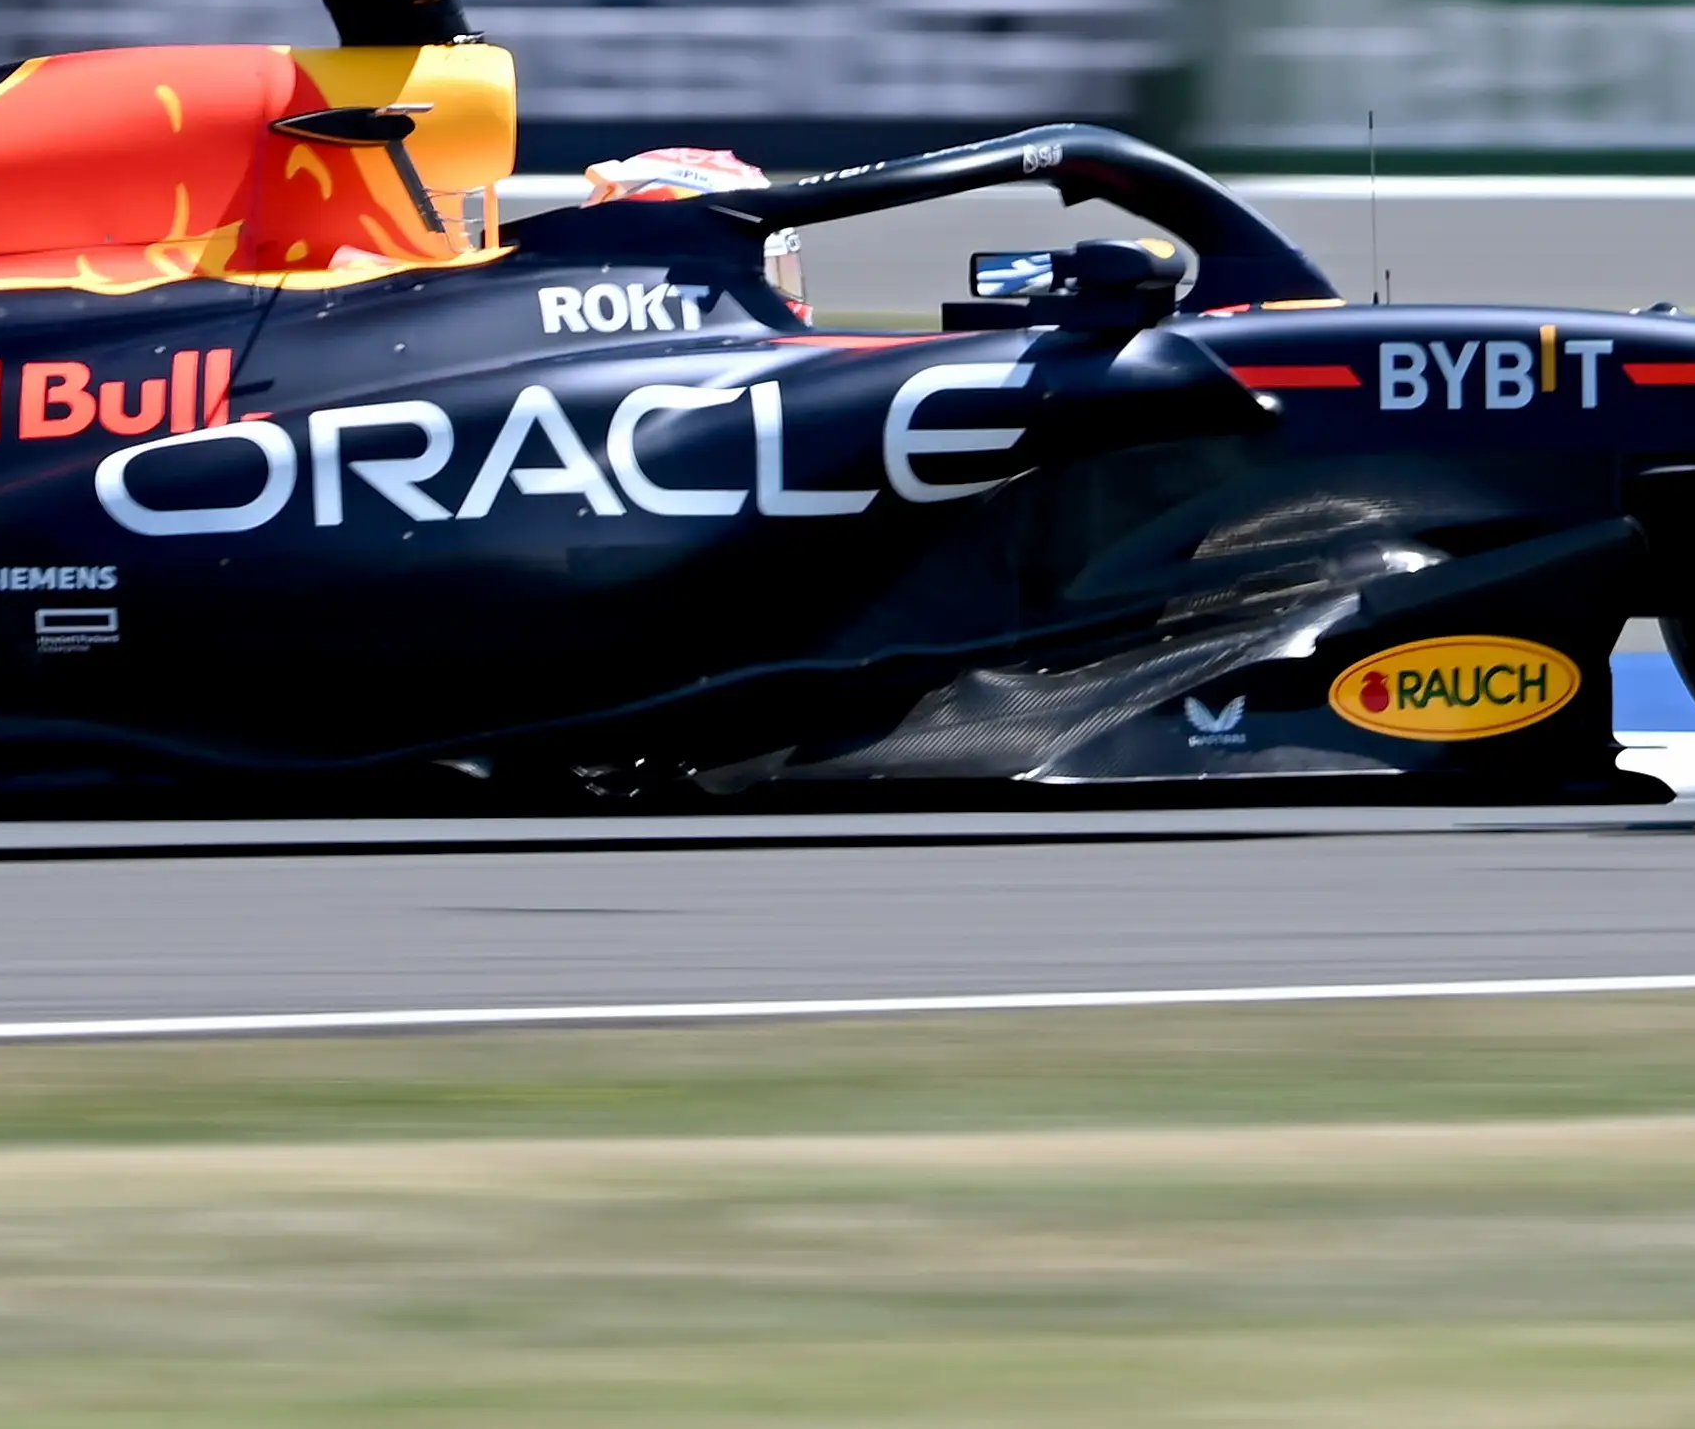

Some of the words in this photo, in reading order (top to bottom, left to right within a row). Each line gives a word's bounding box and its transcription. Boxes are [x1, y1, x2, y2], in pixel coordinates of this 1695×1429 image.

[538, 283, 710, 333] ROKT
[19, 348, 233, 440] Bull
[1379, 324, 1614, 410] BYBIT
[95, 361, 1035, 537] ORACLE
[1396, 663, 1549, 710] RAUCH
